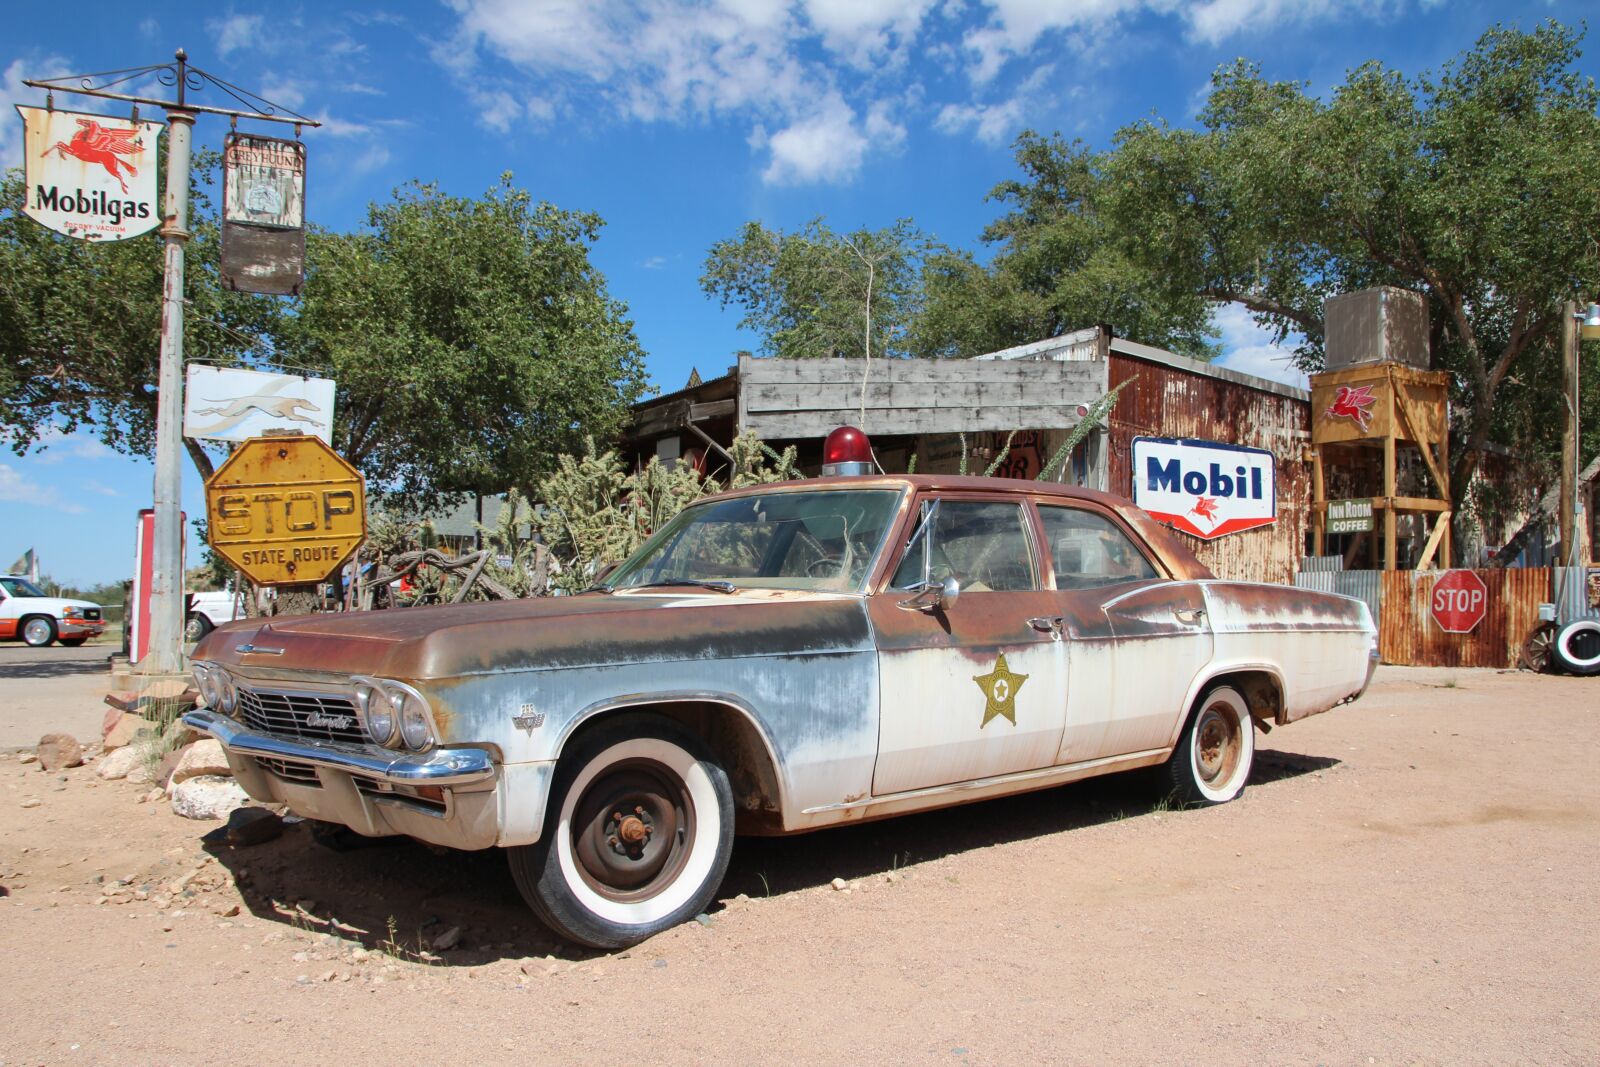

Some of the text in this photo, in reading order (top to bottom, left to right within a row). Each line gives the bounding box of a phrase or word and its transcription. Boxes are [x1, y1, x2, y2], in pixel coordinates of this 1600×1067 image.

[229, 149, 302, 169] GREYHOUND
[37, 184, 150, 225] Mobilgas
[1146, 456, 1263, 500] Mobil
[217, 489, 355, 535] STOP
[1332, 519, 1368, 532] COFFEE
[242, 545, 340, 565] STATE ROUTE
[1434, 588, 1483, 613] STOP
